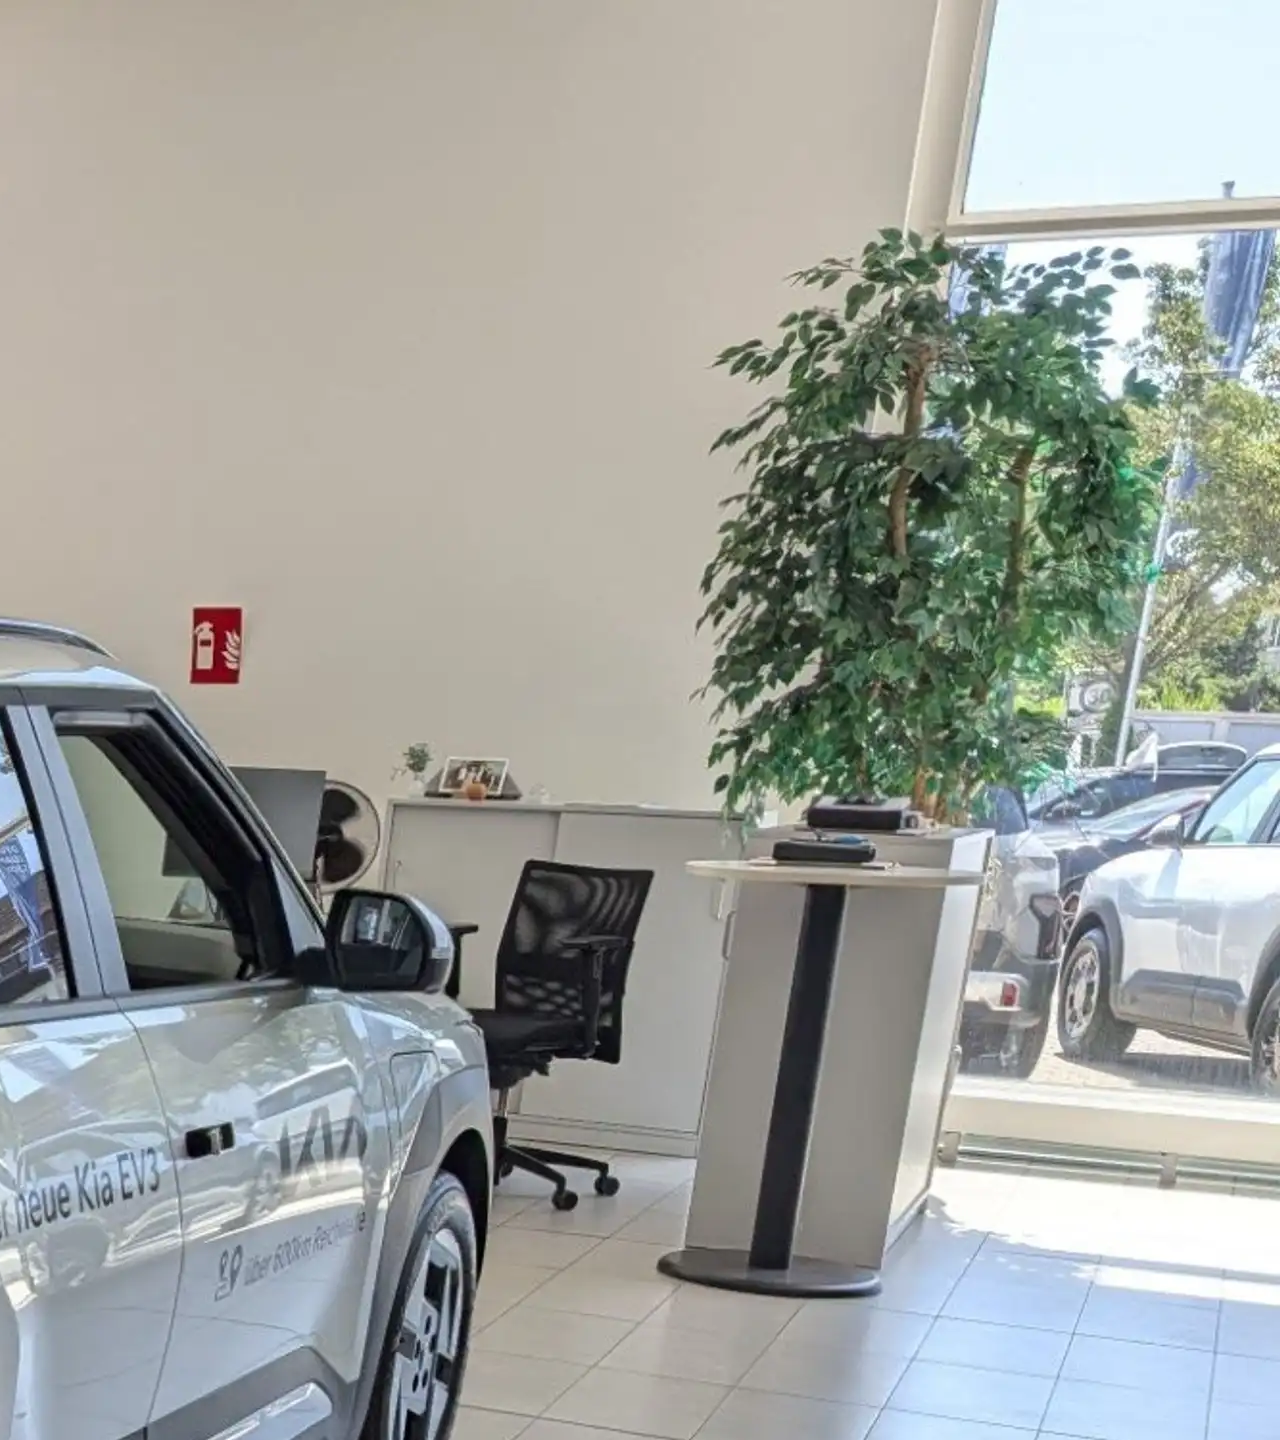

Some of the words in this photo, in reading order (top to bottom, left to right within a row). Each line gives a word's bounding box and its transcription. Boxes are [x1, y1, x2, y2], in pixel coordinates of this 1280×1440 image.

[14, 1181, 71, 1234] neue
[74, 1161, 114, 1213] Kia
[117, 1146, 161, 1200] EV3
